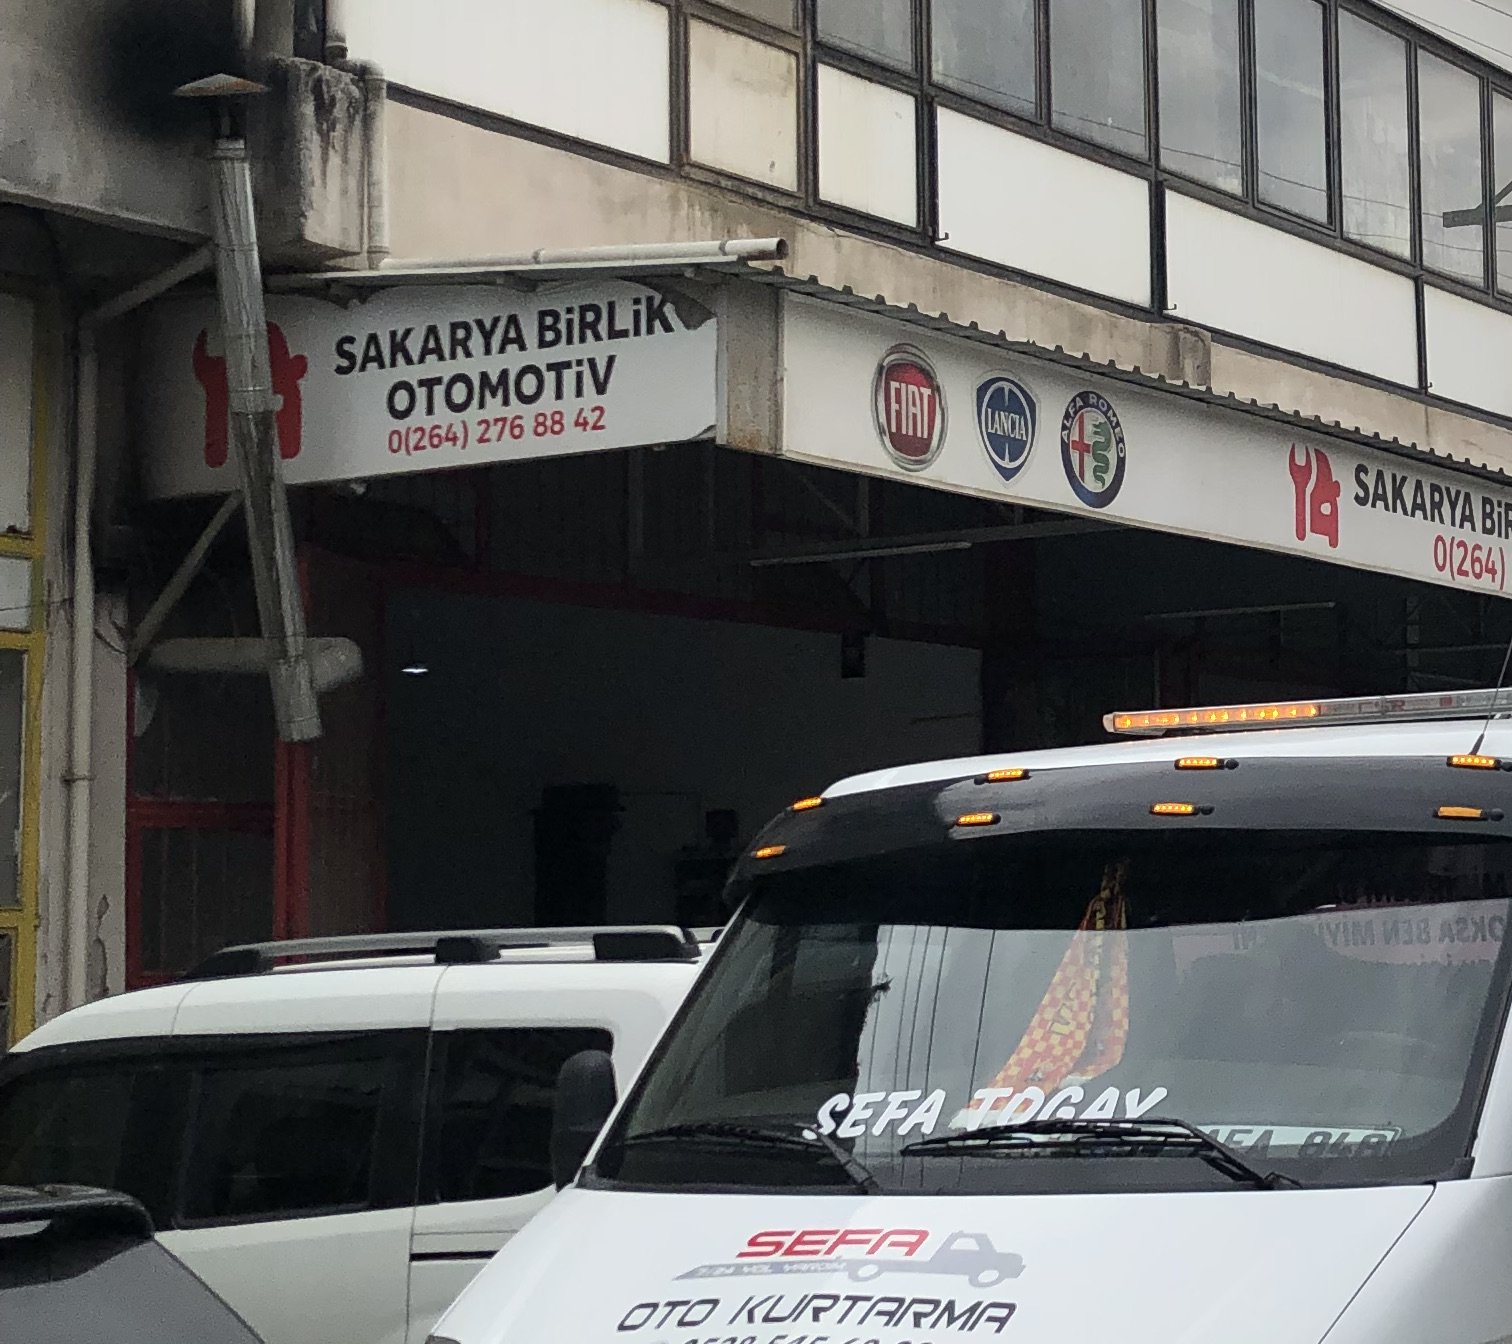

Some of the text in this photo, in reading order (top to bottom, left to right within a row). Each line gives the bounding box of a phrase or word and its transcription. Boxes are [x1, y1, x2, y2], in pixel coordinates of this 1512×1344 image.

[334, 311, 527, 375] SAKARYA
[388, 406, 607, 455] 0(264) 276 88 42
[889, 381, 933, 439] FIAT
[988, 408, 1027, 441] LANCIA
[1061, 392, 1126, 458] ALFA ROMEO
[1354, 464, 1476, 533] SAKARYA
[1433, 534, 1506, 589] 0(264)
[802, 1089, 946, 1140] SEFA
[736, 1228, 930, 1258] SEFA
[617, 1293, 1018, 1335] OTO KURTARMA
